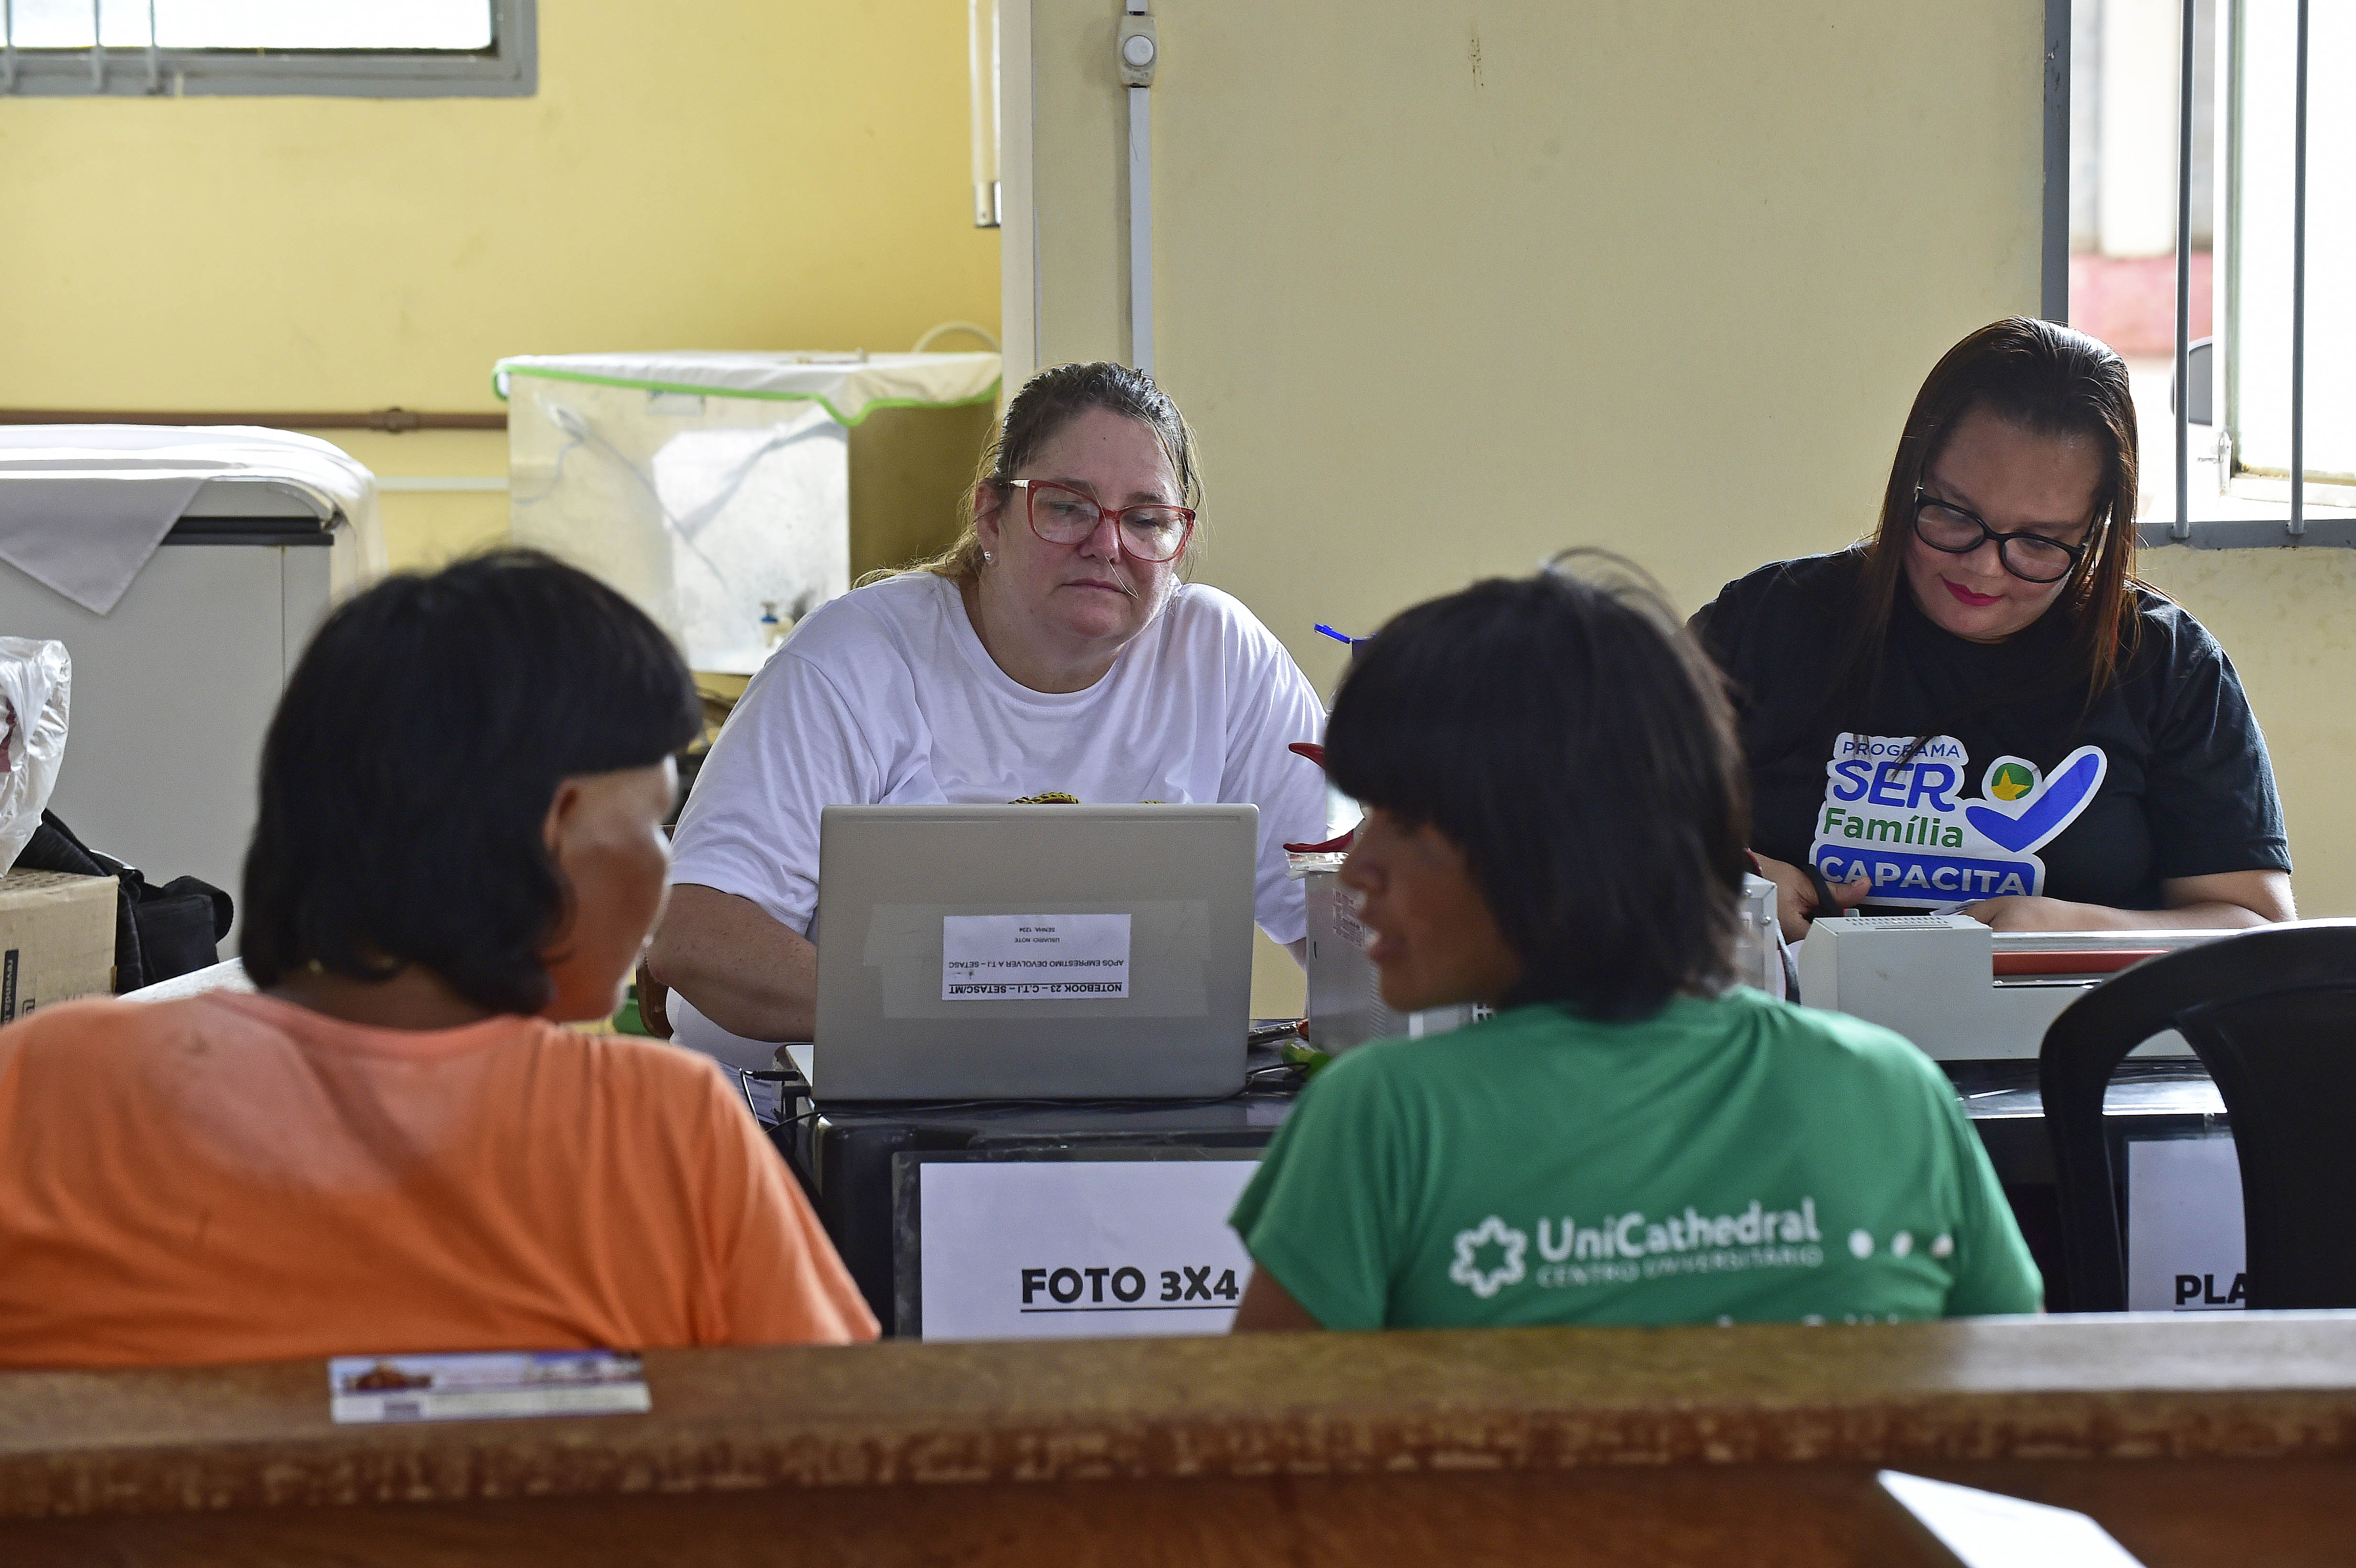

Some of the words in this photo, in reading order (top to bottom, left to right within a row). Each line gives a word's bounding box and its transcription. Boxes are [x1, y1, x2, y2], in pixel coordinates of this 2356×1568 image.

[1843, 741, 1960, 758] PROGRAMA
[1833, 759, 1955, 812] SER
[1823, 807, 1963, 848] Família
[1820, 856, 2028, 895] CAPACITA
[949, 985, 1006, 994] SETASC/MT
[1537, 1197, 1822, 1262] UniCathedral
[1021, 1266, 1146, 1304] FOTO
[1159, 1266, 1239, 1301] 3X4
